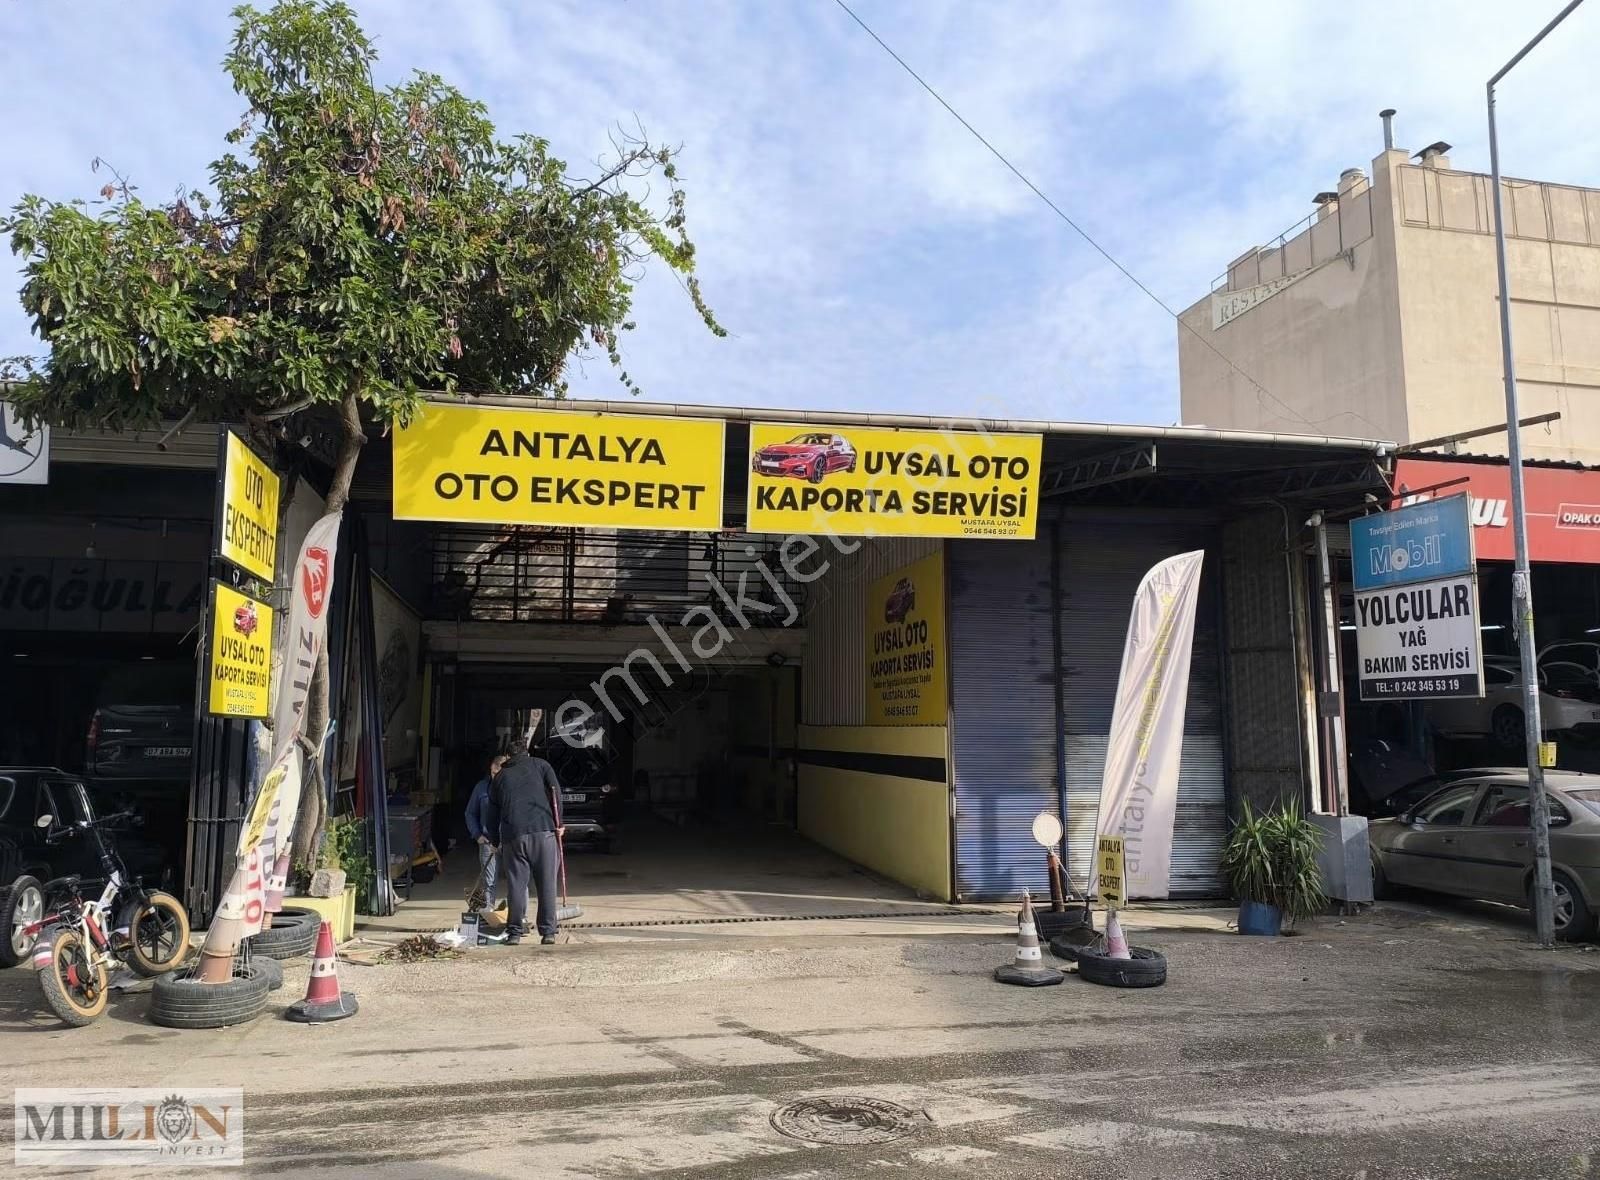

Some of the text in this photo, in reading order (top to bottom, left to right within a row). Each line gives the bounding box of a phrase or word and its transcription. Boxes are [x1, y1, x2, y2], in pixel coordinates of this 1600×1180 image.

[480, 429, 667, 465] ANTALYA
[864, 451, 1030, 480] UYSAL OTO
[244, 466, 264, 510] OTO
[434, 472, 705, 511] OTO EKSPERT
[756, 485, 1027, 518] KAPORTA SERVİSİ
[1369, 513, 1439, 537] Tavsiye Edilen Marka
[1563, 512, 1591, 524] OPAK
[225, 503, 275, 569] EKSPERTİZ
[1370, 533, 1441, 575] Mobil
[1357, 584, 1471, 627] YOLCULAR
[221, 635, 265, 666] UYSAL OTO
[874, 620, 928, 655] UYSAL OTO
[1399, 626, 1427, 647] YAĞ
[870, 643, 934, 678] KAPORTA SERVİSİ
[1364, 647, 1470, 674] BAKIM SERVİSİ
[215, 664, 267, 688] KAPORTA SERVİSİ
[1395, 681, 1400, 691] 0
[1402, 681, 1417, 691] 242
[1419, 680, 1433, 691] 345
[1435, 680, 1447, 690] 53
[1449, 679, 1460, 690] 19
[1099, 839, 1121, 853] ANTALYA
[1105, 858, 1115, 871] OTO
[1099, 876, 1121, 890] EKSPERT
